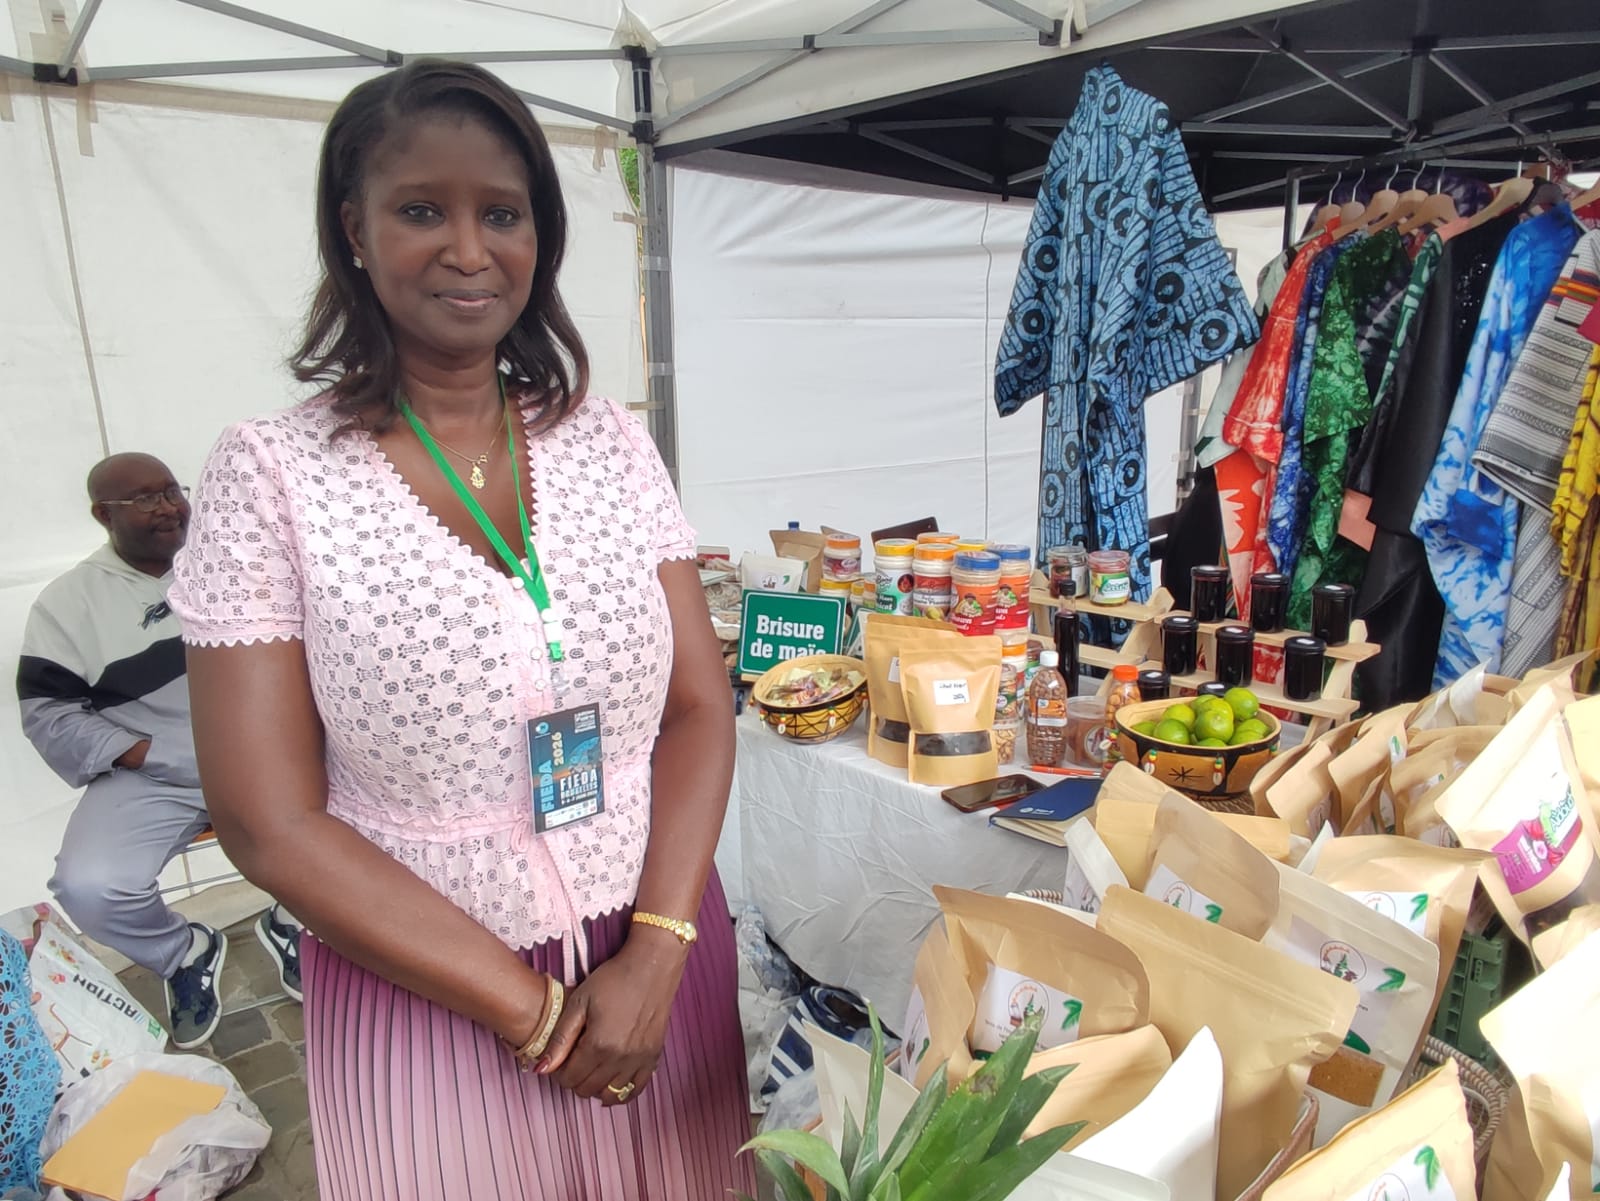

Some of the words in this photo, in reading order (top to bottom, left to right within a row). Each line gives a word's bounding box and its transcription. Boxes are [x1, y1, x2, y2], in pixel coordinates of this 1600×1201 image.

[756, 614, 825, 640] Brisure
[750, 638, 773, 659] de
[552, 731, 564, 766] 2026
[538, 759, 555, 813] FIEDA
[560, 768, 598, 792] FIEDA
[72, 973, 138, 1018] ACTION
